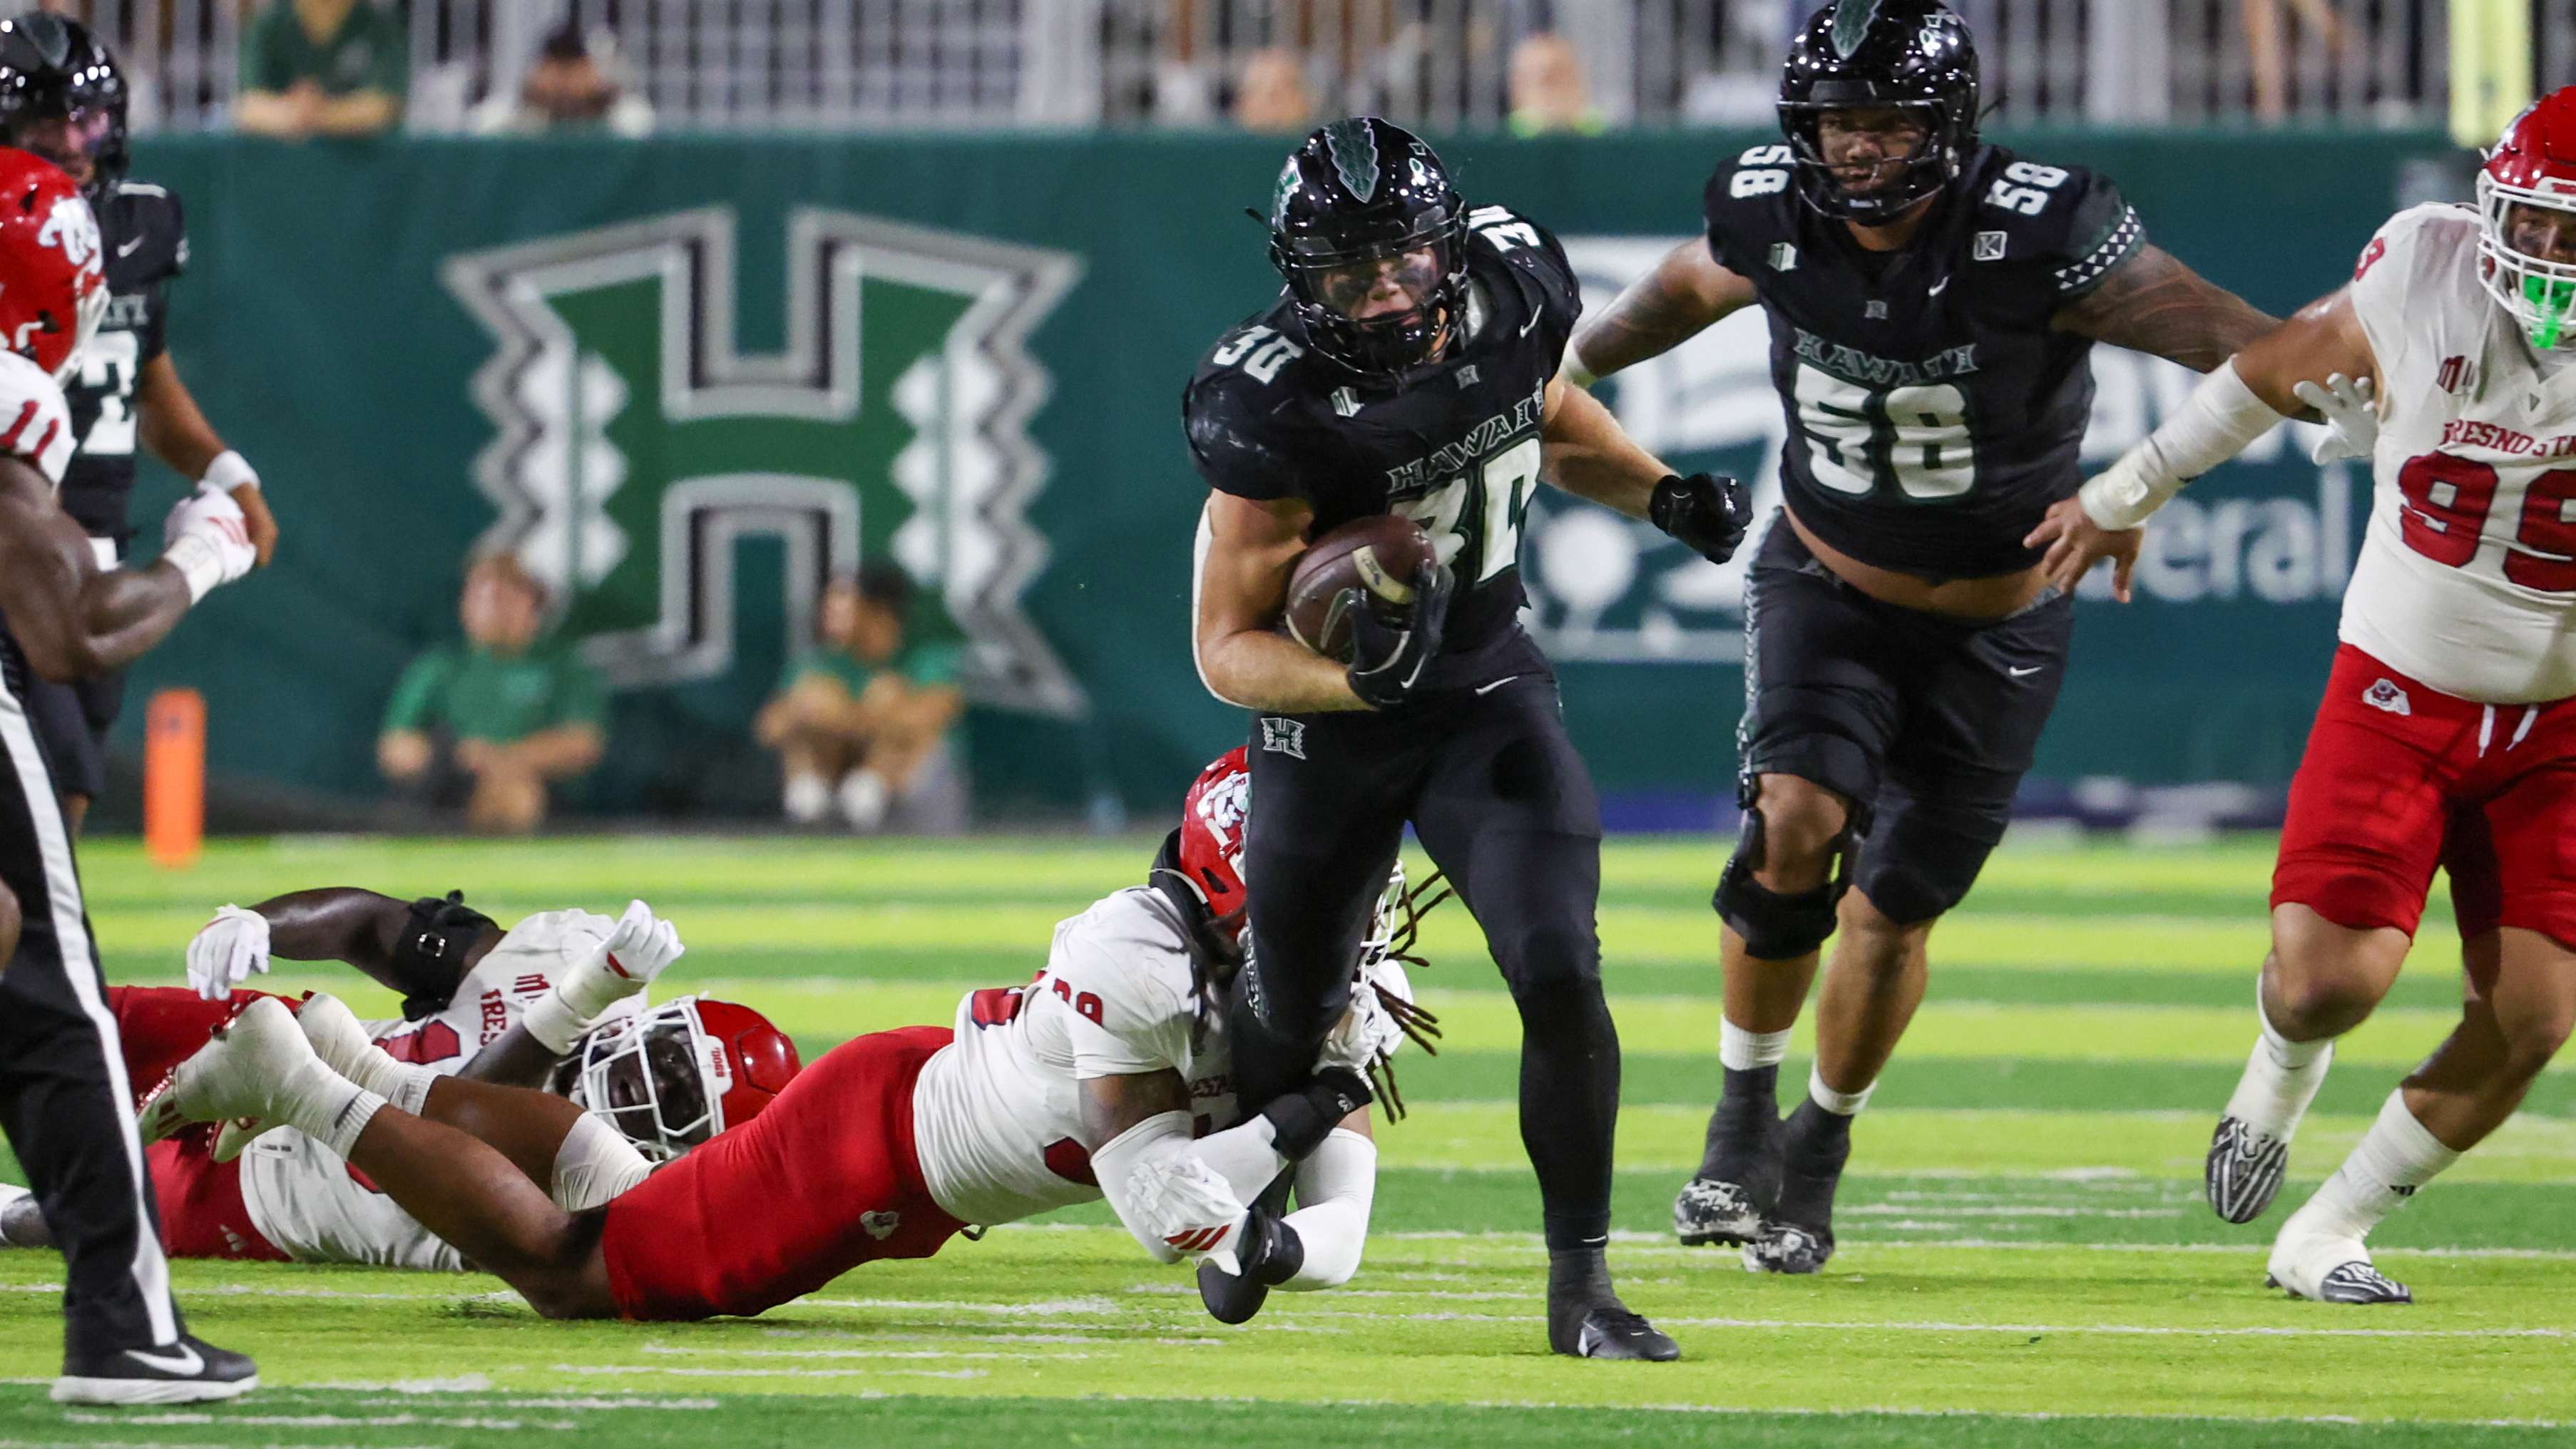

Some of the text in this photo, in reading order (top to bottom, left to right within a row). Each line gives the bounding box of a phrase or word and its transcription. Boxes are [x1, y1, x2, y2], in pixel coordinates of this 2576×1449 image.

[1730, 145, 1796, 199] 58
[1984, 161, 2069, 215] 58
[1213, 325, 1303, 385] 30
[1794, 364, 1976, 498] 58
[1391, 437, 1541, 583] 30
[2397, 451, 2576, 591] 99
[1260, 717, 1307, 760] H
